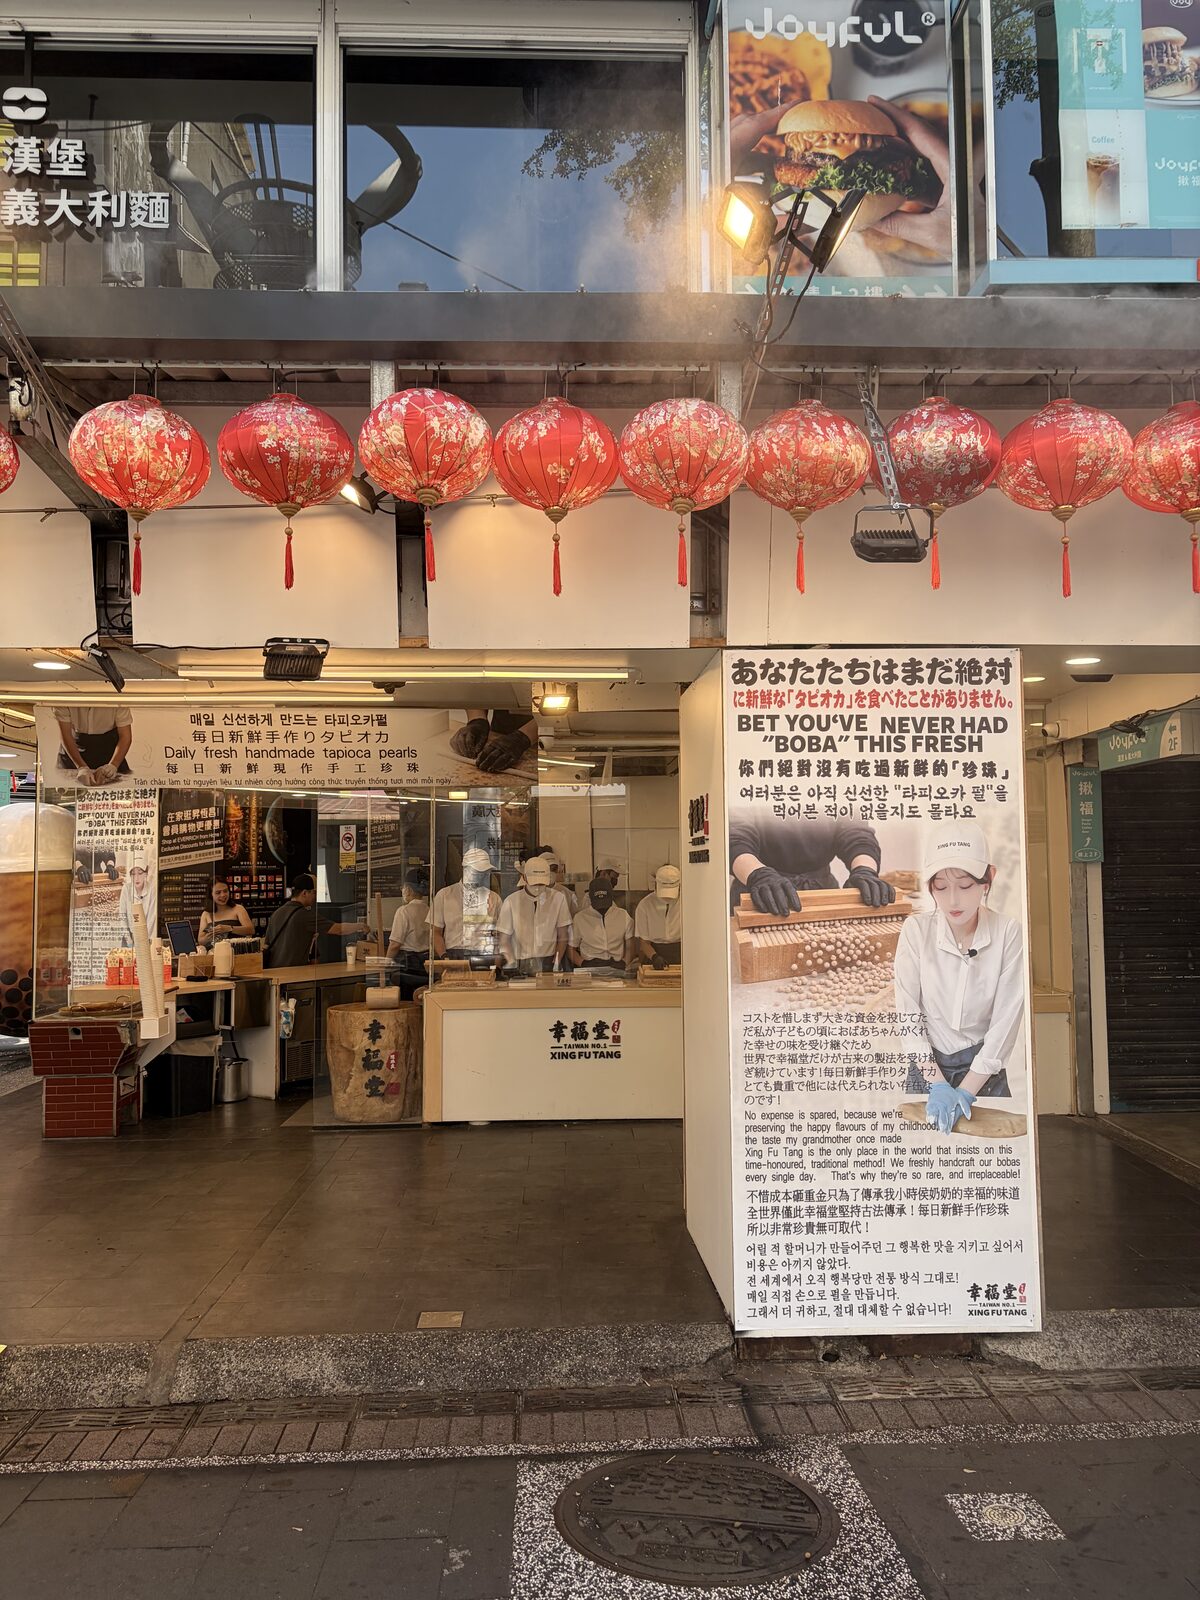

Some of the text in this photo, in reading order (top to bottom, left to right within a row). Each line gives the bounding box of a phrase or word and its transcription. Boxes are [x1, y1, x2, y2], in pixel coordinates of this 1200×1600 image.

[1091, 135, 1115, 144] Coffee
[2, 136, 87, 177] 漢堡
[0, 188, 170, 229] 義大利麵
[731, 657, 1013, 686] あなたたちはまだ絶対
[189, 712, 387, 727] 매일 신선하게 만드는 타피오카펄
[737, 714, 780, 732] BET
[880, 716, 955, 734] NEVER
[960, 716, 1008, 734] HAD
[853, 734, 906, 752] THIS
[911, 734, 982, 752] FRESH
[1168, 737, 1178, 751] 2F
[164, 746, 417, 761] Daily fresh handmade tapioca pearls
[739, 784, 801, 802] 여러분은
[807, 784, 836, 802] 아직
[842, 784, 889, 801] 신선한
[772, 802, 976, 821] 먹어본 적이 없을지도 몰라요
[549, 1020, 610, 1043] 幸福堂
[362, 1019, 386, 1098] 幸福堂
[550, 1051, 621, 1060] XING FU TANG
[743, 1093, 780, 1106] のです!
[744, 1108, 903, 1122] No expense is spared, because we're
[744, 1121, 939, 1134] preserving the happy flavours of my childhood,
[744, 1133, 902, 1146] the taste my grandmother once made
[744, 1144, 1012, 1159] Xing Fu Tang is the only place in the world that insists on this
[744, 1156, 1020, 1171] time-honoured, traditional method! We freshly handcraft our bobas
[744, 1169, 1020, 1184] every single day. That's why they're so rare, and irreplaceable!
[745, 1238, 1023, 1256] 어릴 적 할머니가 만들어주던 그 행복한 맛을 지키고 싶어서
[746, 1256, 850, 1272] 비용은 아끼지 않았다.
[746, 1271, 958, 1287] 전 세계에서 오직 행복당만 전통 방식 그대로!
[746, 1287, 899, 1303] 매일 직접 손으로 펄을 만듭니다.
[967, 1283, 1017, 1302] 幸福堂
[746, 1302, 951, 1319] 그래서 더 귀하고, 절대 대체할 수 없습니다!
